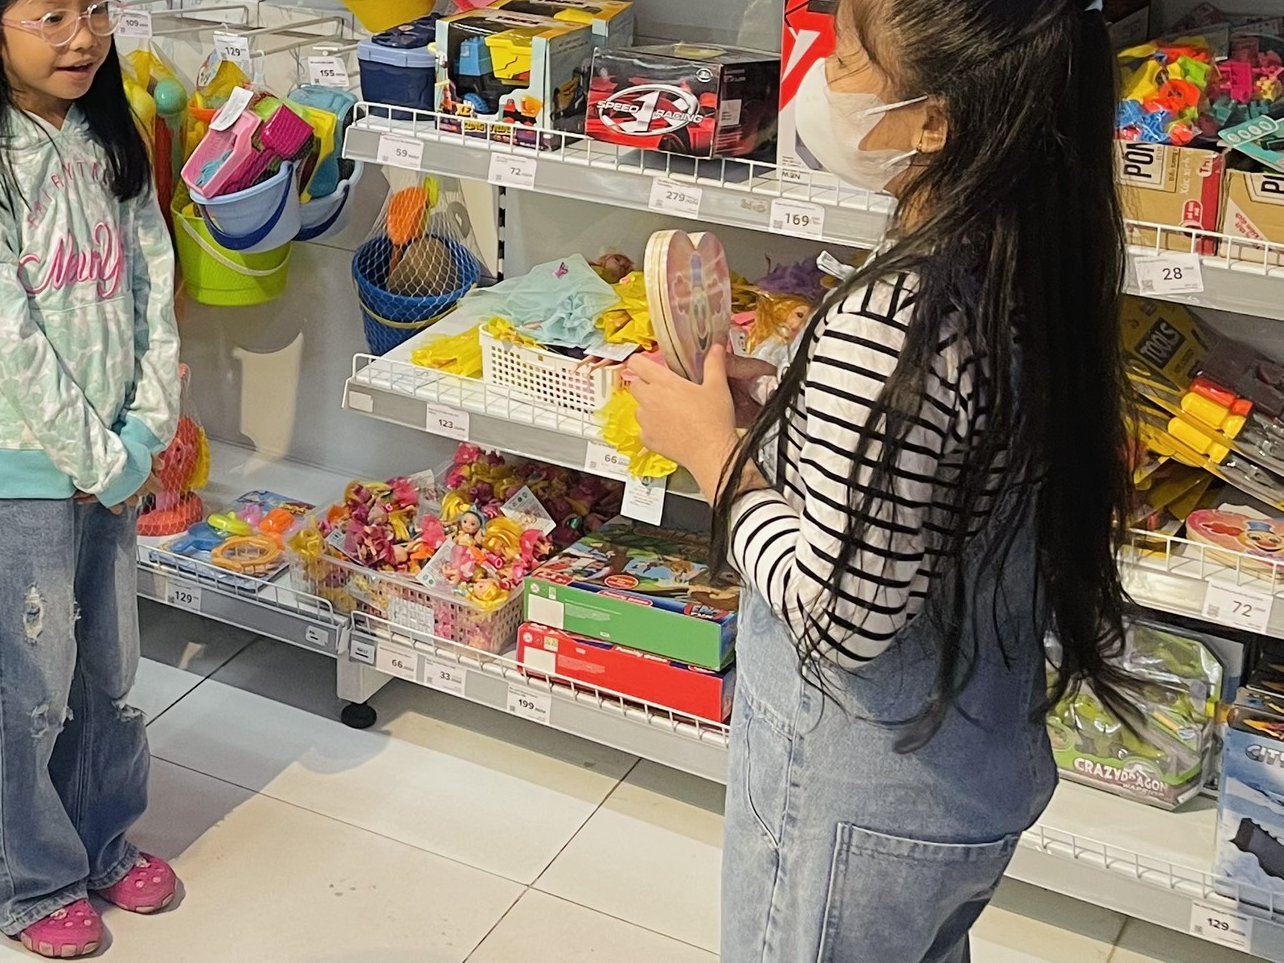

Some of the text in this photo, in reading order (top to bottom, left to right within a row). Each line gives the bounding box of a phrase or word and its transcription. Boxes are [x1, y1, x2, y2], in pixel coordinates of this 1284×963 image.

[125, 19, 139, 27] 109
[225, 46, 241, 57] 129
[319, 68, 335, 78] 155
[596, 100, 640, 114] SPEED
[654, 110, 704, 124] RACING
[396, 149, 408, 158] 59
[510, 167, 521, 176] 72
[666, 190, 685, 202] 279
[784, 212, 810, 227] 169
[1162, 267, 1183, 281] 28
[1139, 320, 1178, 364] TOOLS
[438, 419, 454, 429] 123
[604, 453, 617, 464] 66
[173, 590, 193, 603] 129
[1232, 600, 1253, 618] 72
[392, 658, 403, 668] 66
[439, 670, 451, 681] 33
[518, 698, 535, 710] 199
[1245, 743, 1284, 767] CIT
[1206, 917, 1230, 932] 129
